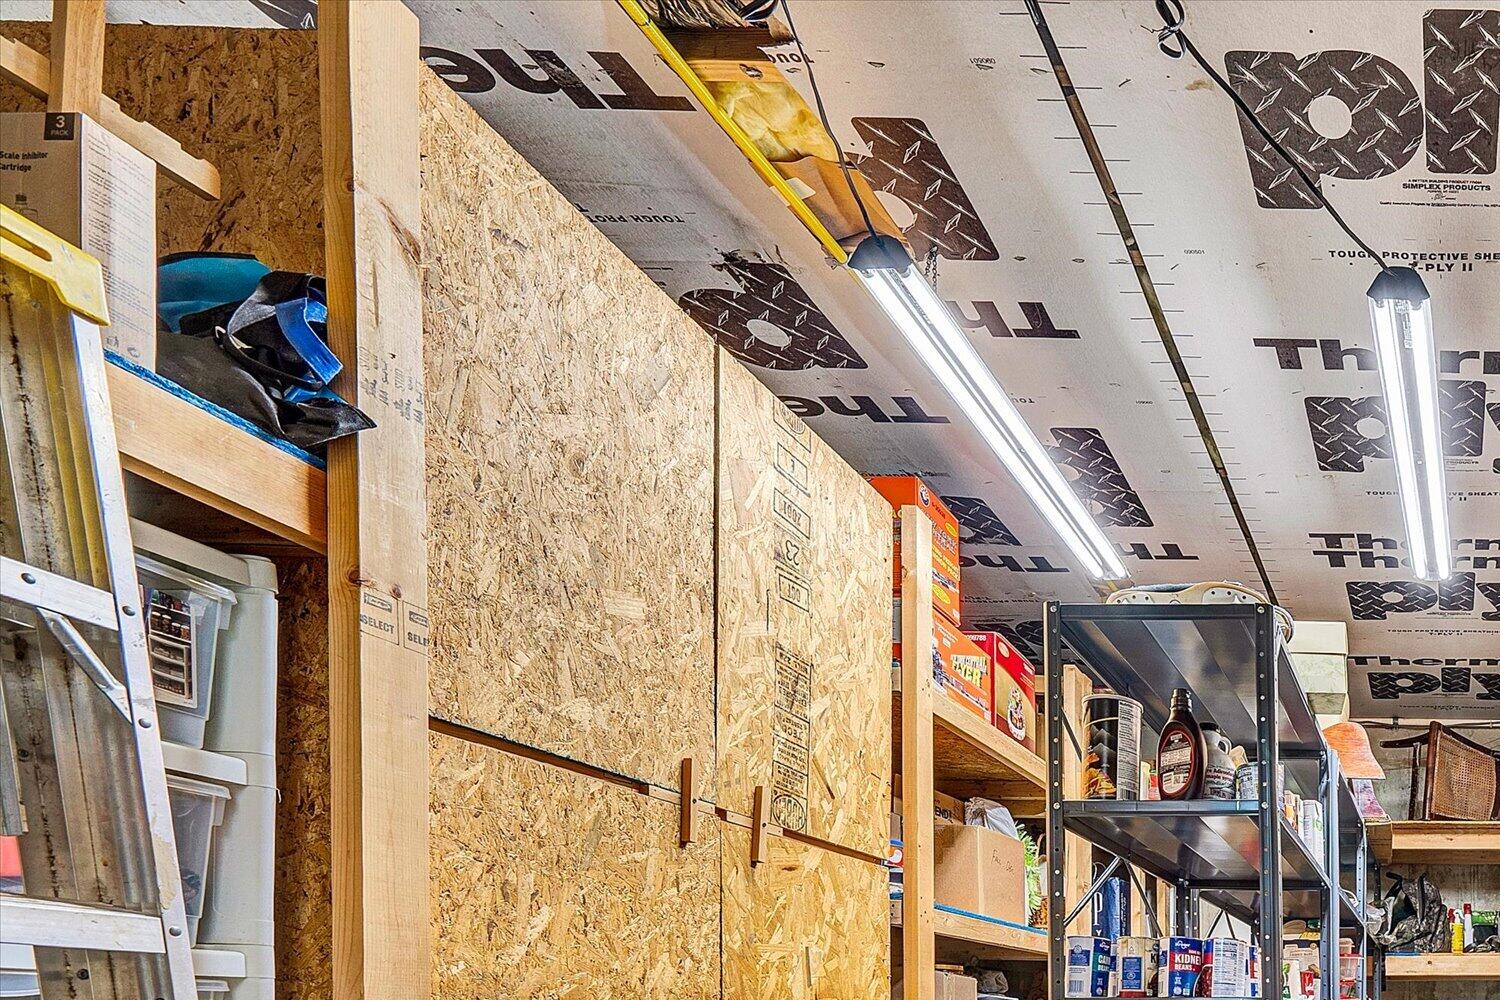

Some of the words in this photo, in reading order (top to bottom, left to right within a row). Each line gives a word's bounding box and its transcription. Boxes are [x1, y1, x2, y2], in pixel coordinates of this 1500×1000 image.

[419, 46, 698, 112] The
[55, 115, 65, 128] 3
[51, 129, 69, 137] PACK
[22, 151, 48, 159] Inhibitor
[632, 215, 686, 224] TOUGH
[1382, 251, 1469, 261] PROTECTIVE
[1462, 263, 1473, 272] II
[361, 613, 395, 635] SELECT
